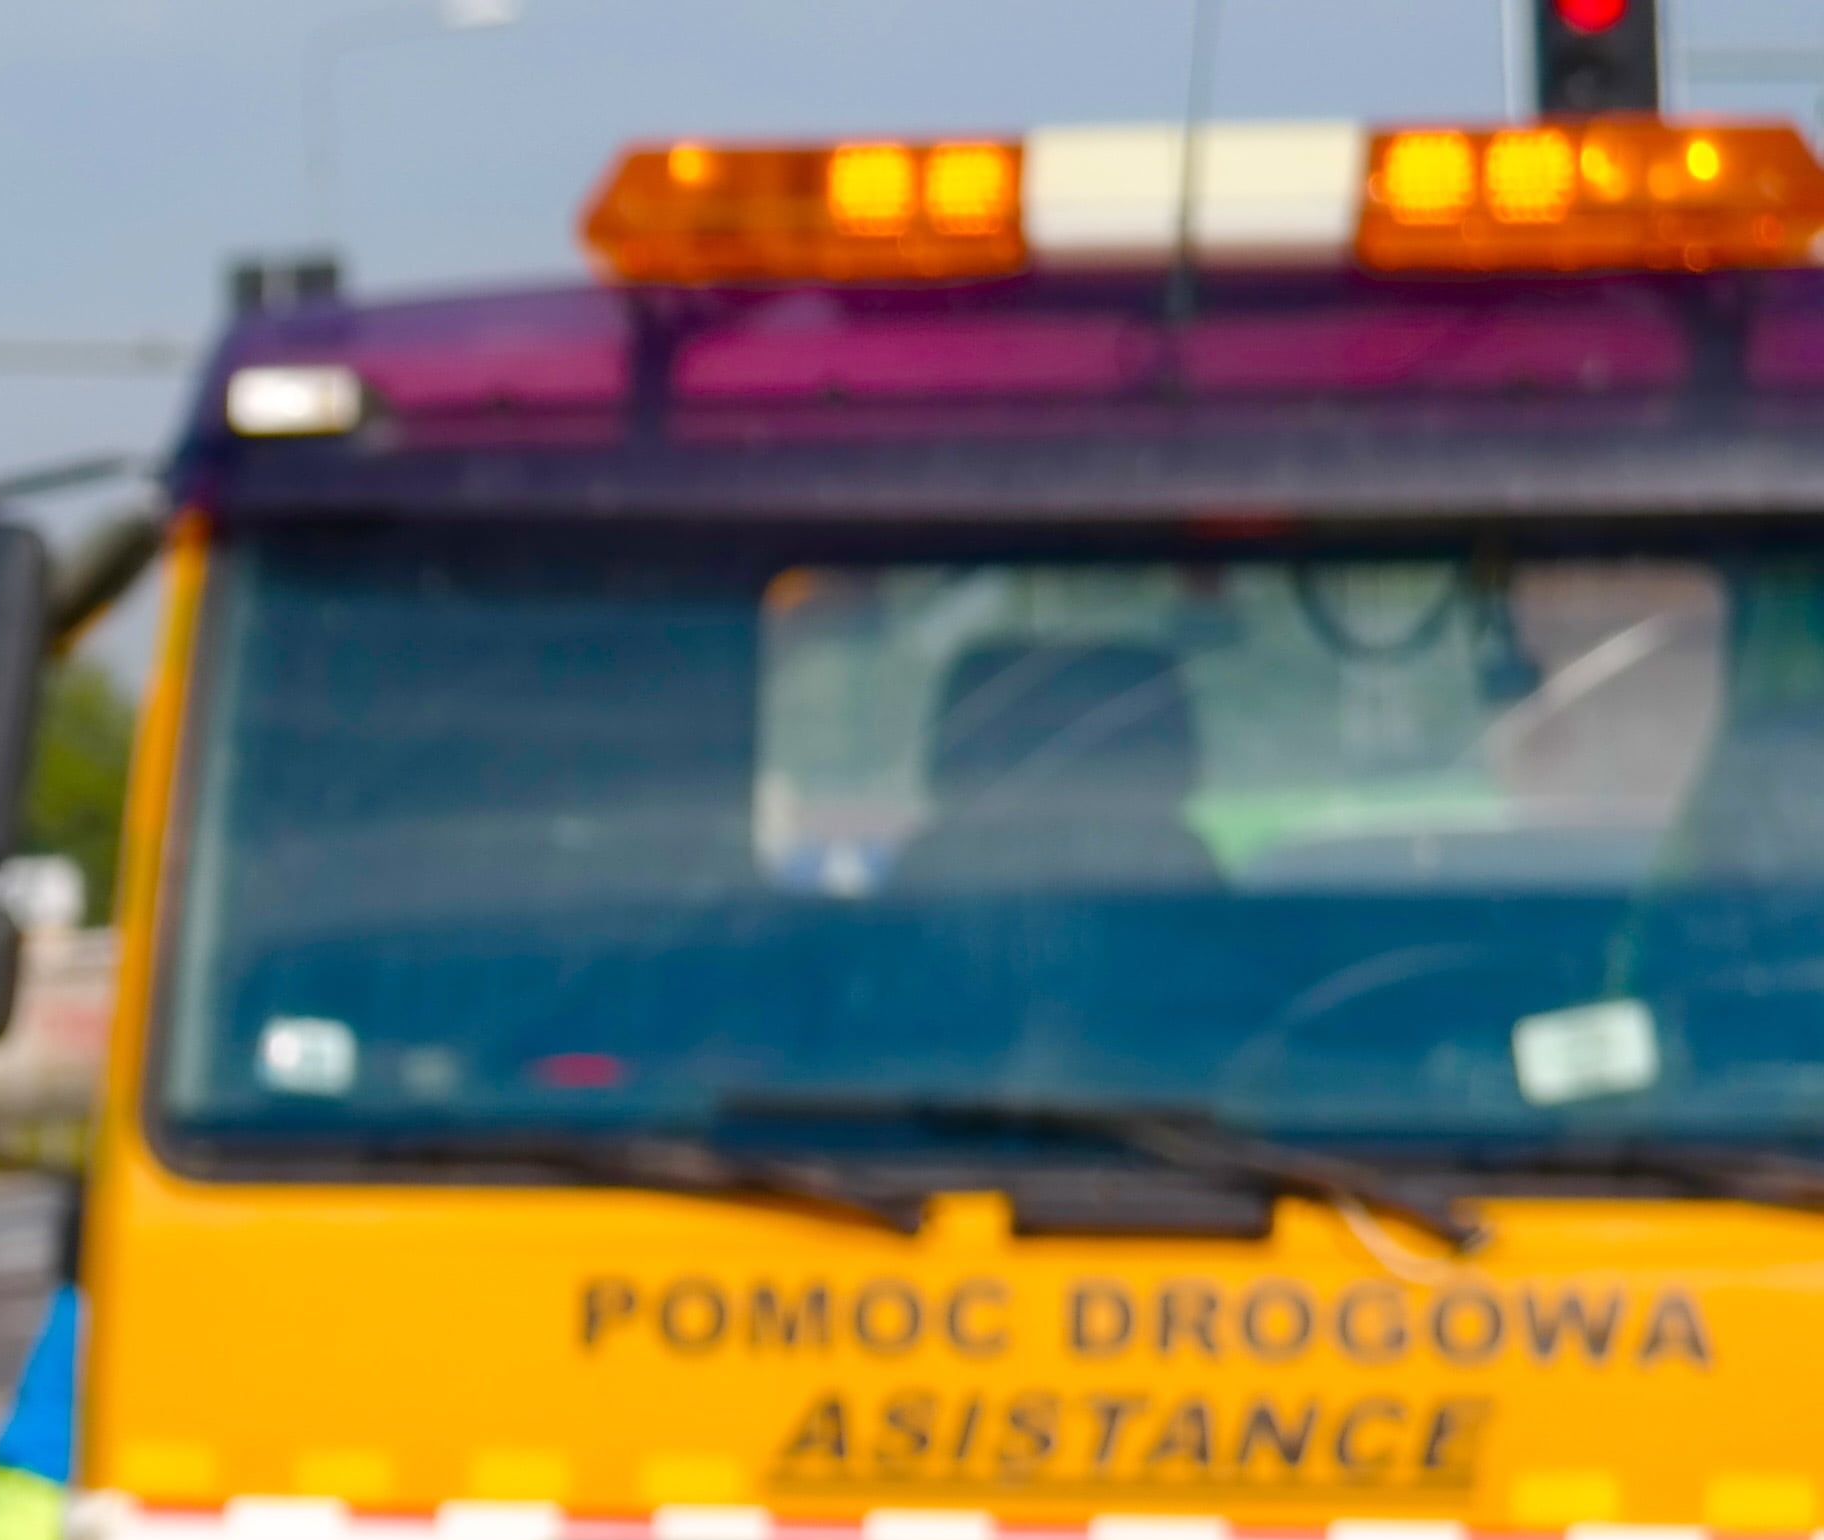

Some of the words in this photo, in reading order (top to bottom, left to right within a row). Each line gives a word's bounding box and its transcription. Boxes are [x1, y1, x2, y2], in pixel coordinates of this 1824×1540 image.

[581, 1276, 1012, 1358] POMOC
[1066, 1275, 1712, 1370] DROGOWA
[782, 1388, 1492, 1470] ASISTANCE
